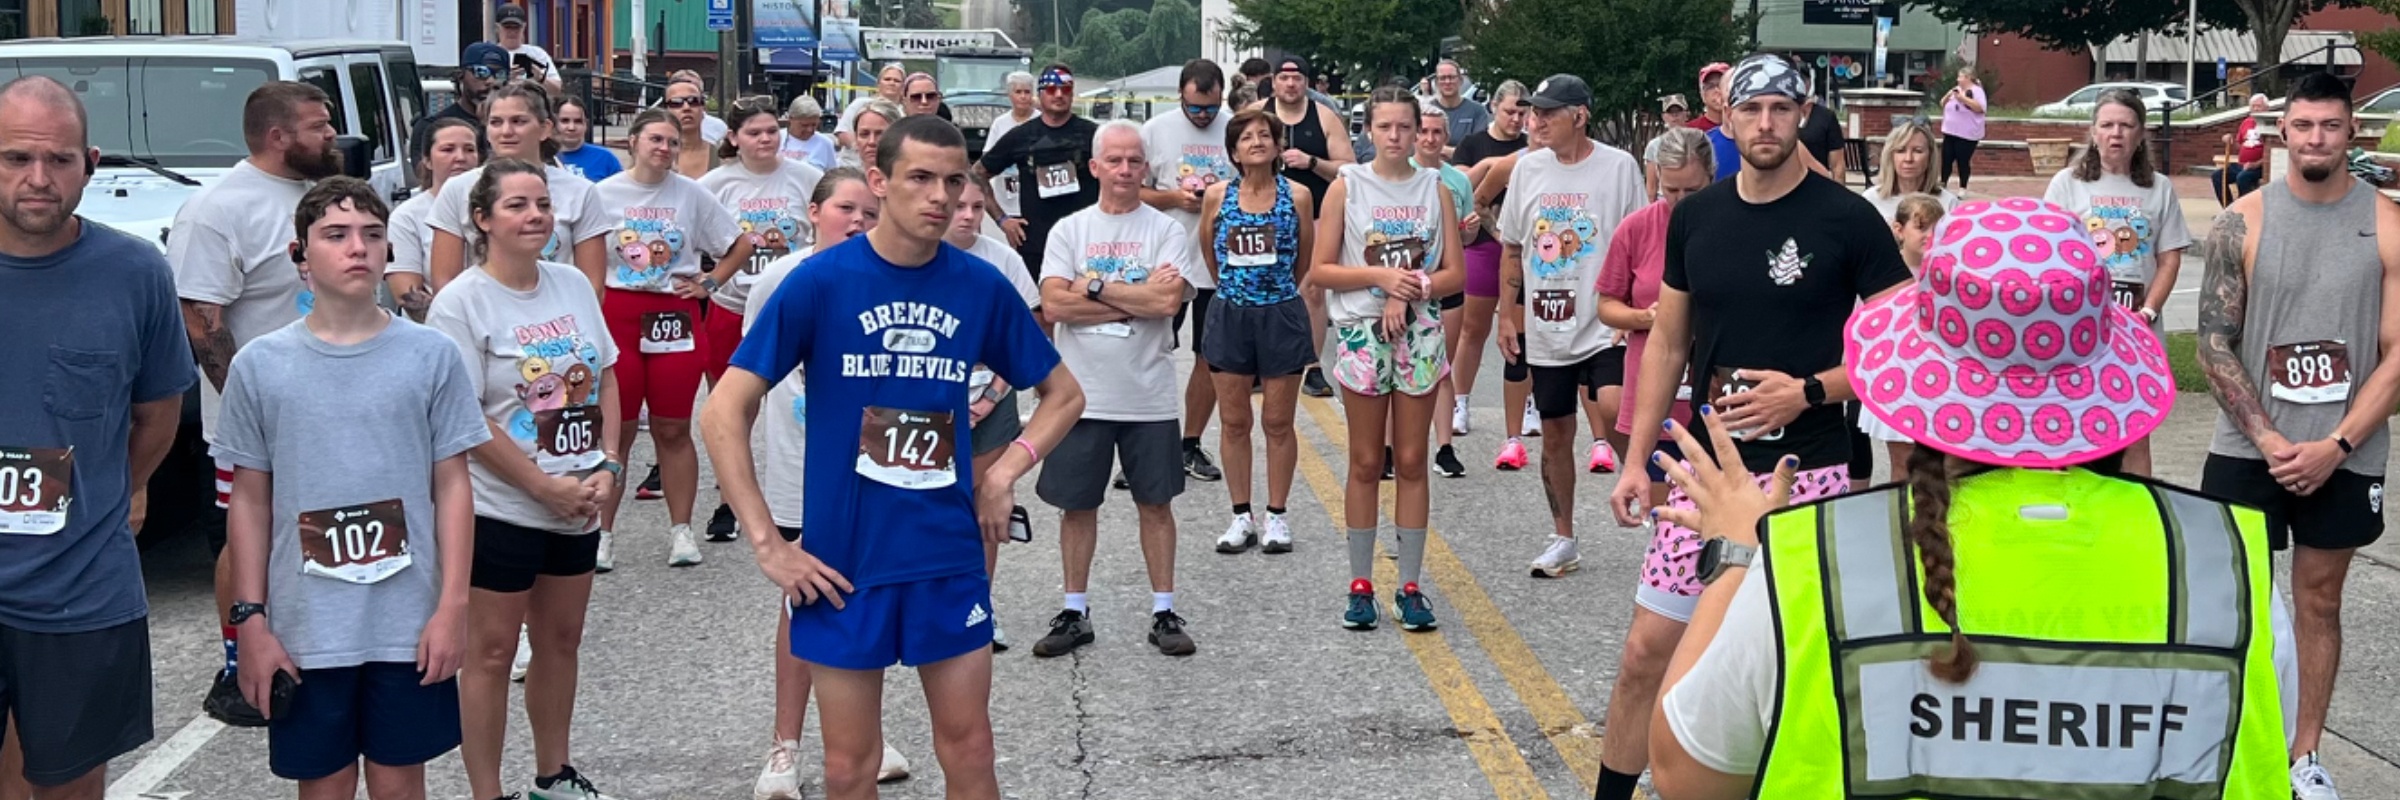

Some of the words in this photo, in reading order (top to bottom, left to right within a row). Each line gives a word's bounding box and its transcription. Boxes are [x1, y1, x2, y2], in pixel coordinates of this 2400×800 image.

[900, 38, 960, 50] FINISH
[1045, 169, 1070, 187] 120
[740, 198, 789, 211] DONUT
[1539, 193, 1589, 207] DONUT
[624, 207, 678, 220] DONUT
[740, 210, 776, 222] DASH
[1371, 206, 1428, 221] DONUT
[1539, 207, 1572, 221] DASH
[1086, 242, 1142, 257] DONUT
[1235, 234, 1266, 254] 115
[749, 255, 777, 274] 10
[1380, 249, 1412, 271] 121
[1541, 299, 1567, 319] 797
[2113, 290, 2133, 310] 10
[513, 314, 578, 346] DONUT
[652, 319, 682, 340] 698
[857, 301, 961, 339] BREMEN
[841, 353, 893, 378] BLUE
[895, 354, 967, 383] DEVILS
[2286, 353, 2334, 386] 898
[555, 420, 592, 453] 605
[884, 426, 939, 466] 142
[0, 466, 43, 507] 03
[325, 520, 387, 563] 102
[1909, 692, 2188, 749] SHERIFF
